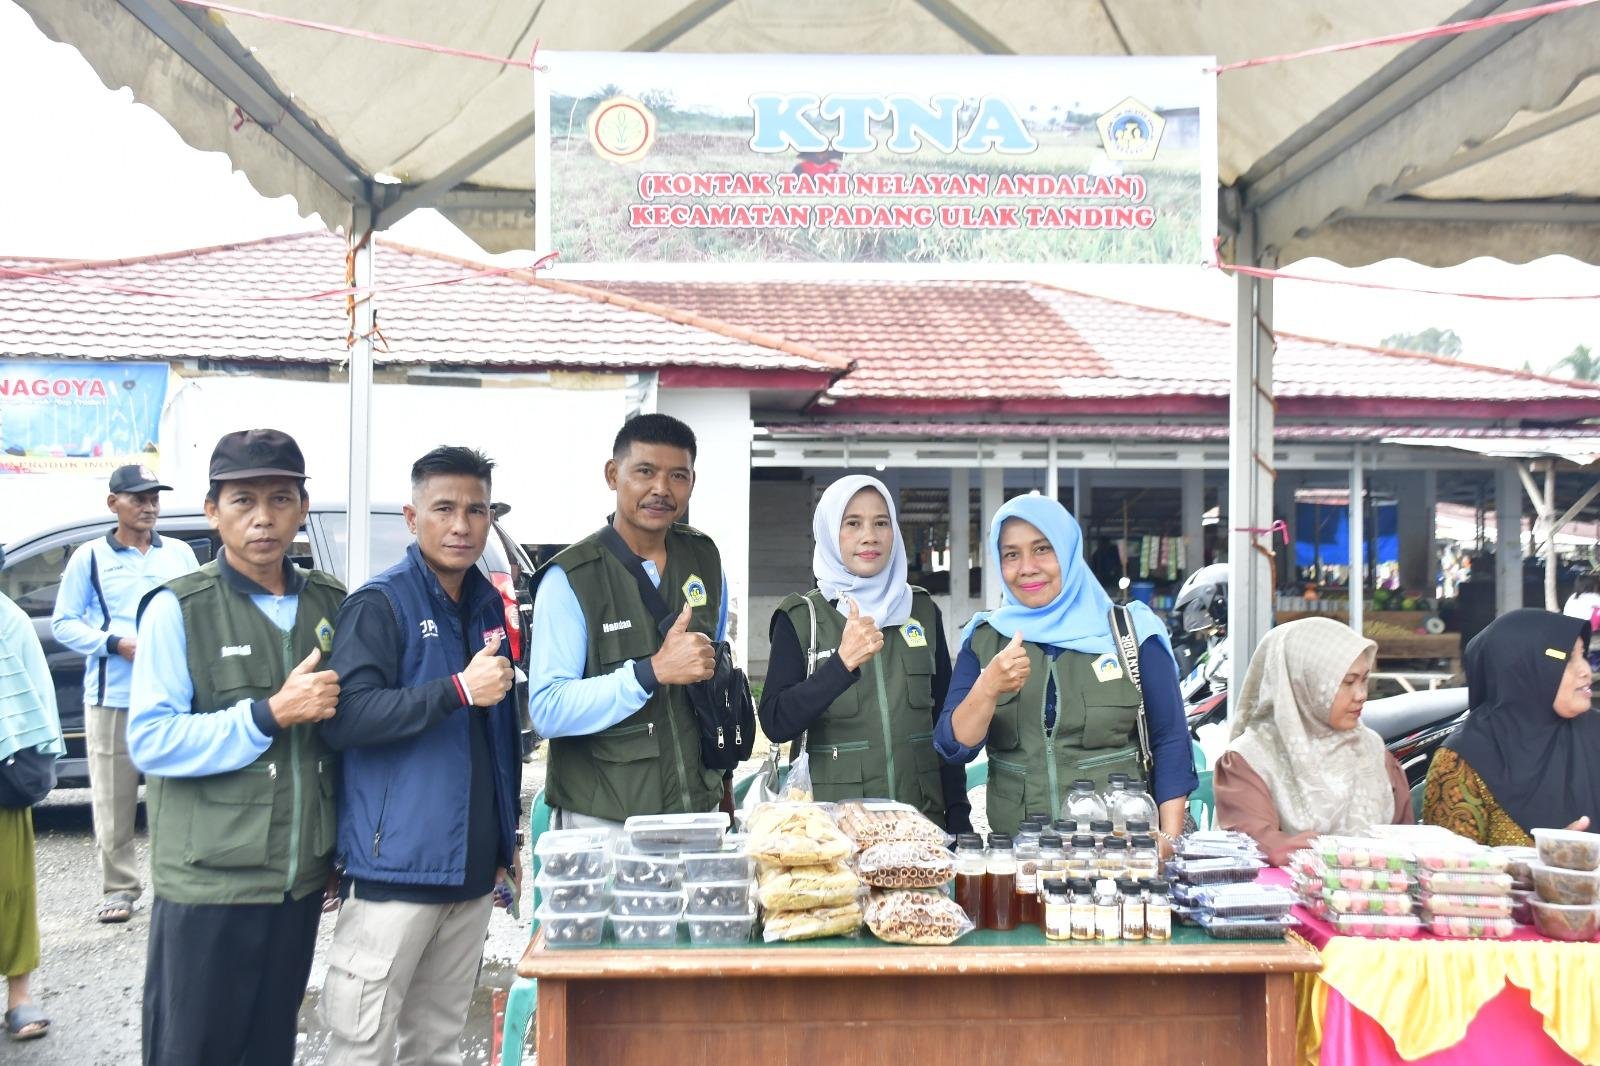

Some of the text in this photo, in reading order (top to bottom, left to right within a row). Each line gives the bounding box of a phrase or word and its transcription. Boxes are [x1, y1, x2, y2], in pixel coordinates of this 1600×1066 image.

[749, 95, 1038, 152] KTNA
[640, 173, 1146, 201] (KONTAK TANI NELAYAN ANDALAN)
[630, 206, 1155, 229] KECAMATAN PADANG ULAK TANDING
[0, 380, 106, 396] NAGOYA
